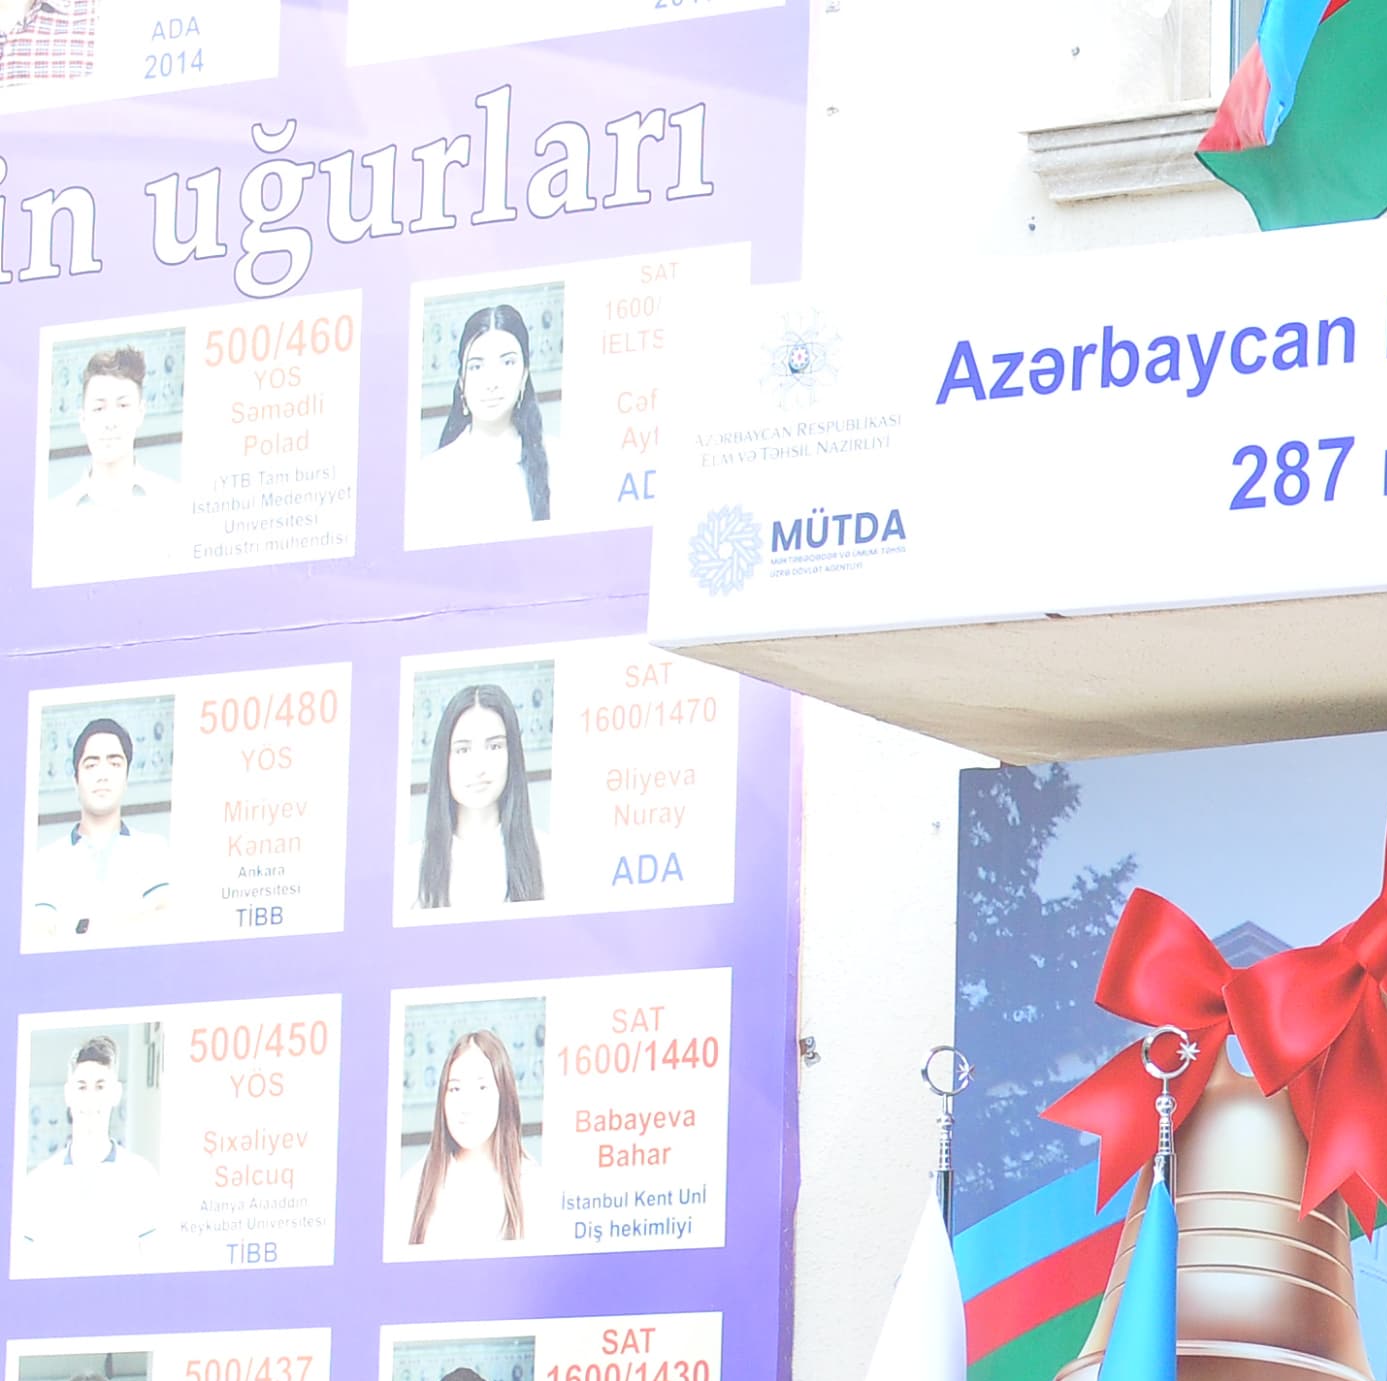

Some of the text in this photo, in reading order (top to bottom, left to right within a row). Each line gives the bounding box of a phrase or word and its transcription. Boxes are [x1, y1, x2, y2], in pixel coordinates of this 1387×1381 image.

[150, 15, 201, 44] ADA
[143, 50, 205, 81] 2014
[145, 82, 714, 300] uğurları
[640, 261, 680, 285] SAT
[205, 314, 354, 368] 500/460
[935, 315, 1355, 405] Azərbaycan
[243, 428, 310, 457] Polad
[1229, 435, 1355, 510] 287
[770, 506, 907, 552] MÜTDA
[625, 661, 673, 688] SAT
[200, 688, 338, 734] 500/480
[580, 696, 717, 733] 1600/1470
[606, 767, 696, 796] Əliyeva
[224, 798, 307, 826] Miriyev
[614, 803, 686, 829] Nuray
[612, 851, 684, 887] ADA
[612, 1006, 665, 1034] SAT
[189, 1019, 329, 1063] 500/450
[558, 1036, 720, 1076] 1600/1440
[575, 1108, 696, 1136] Babayeva
[598, 1143, 672, 1168] Bahar
[634, 1189, 673, 1208] Kent
[574, 1215, 693, 1243] Diş hekimliyi
[601, 1327, 656, 1355] SAT
